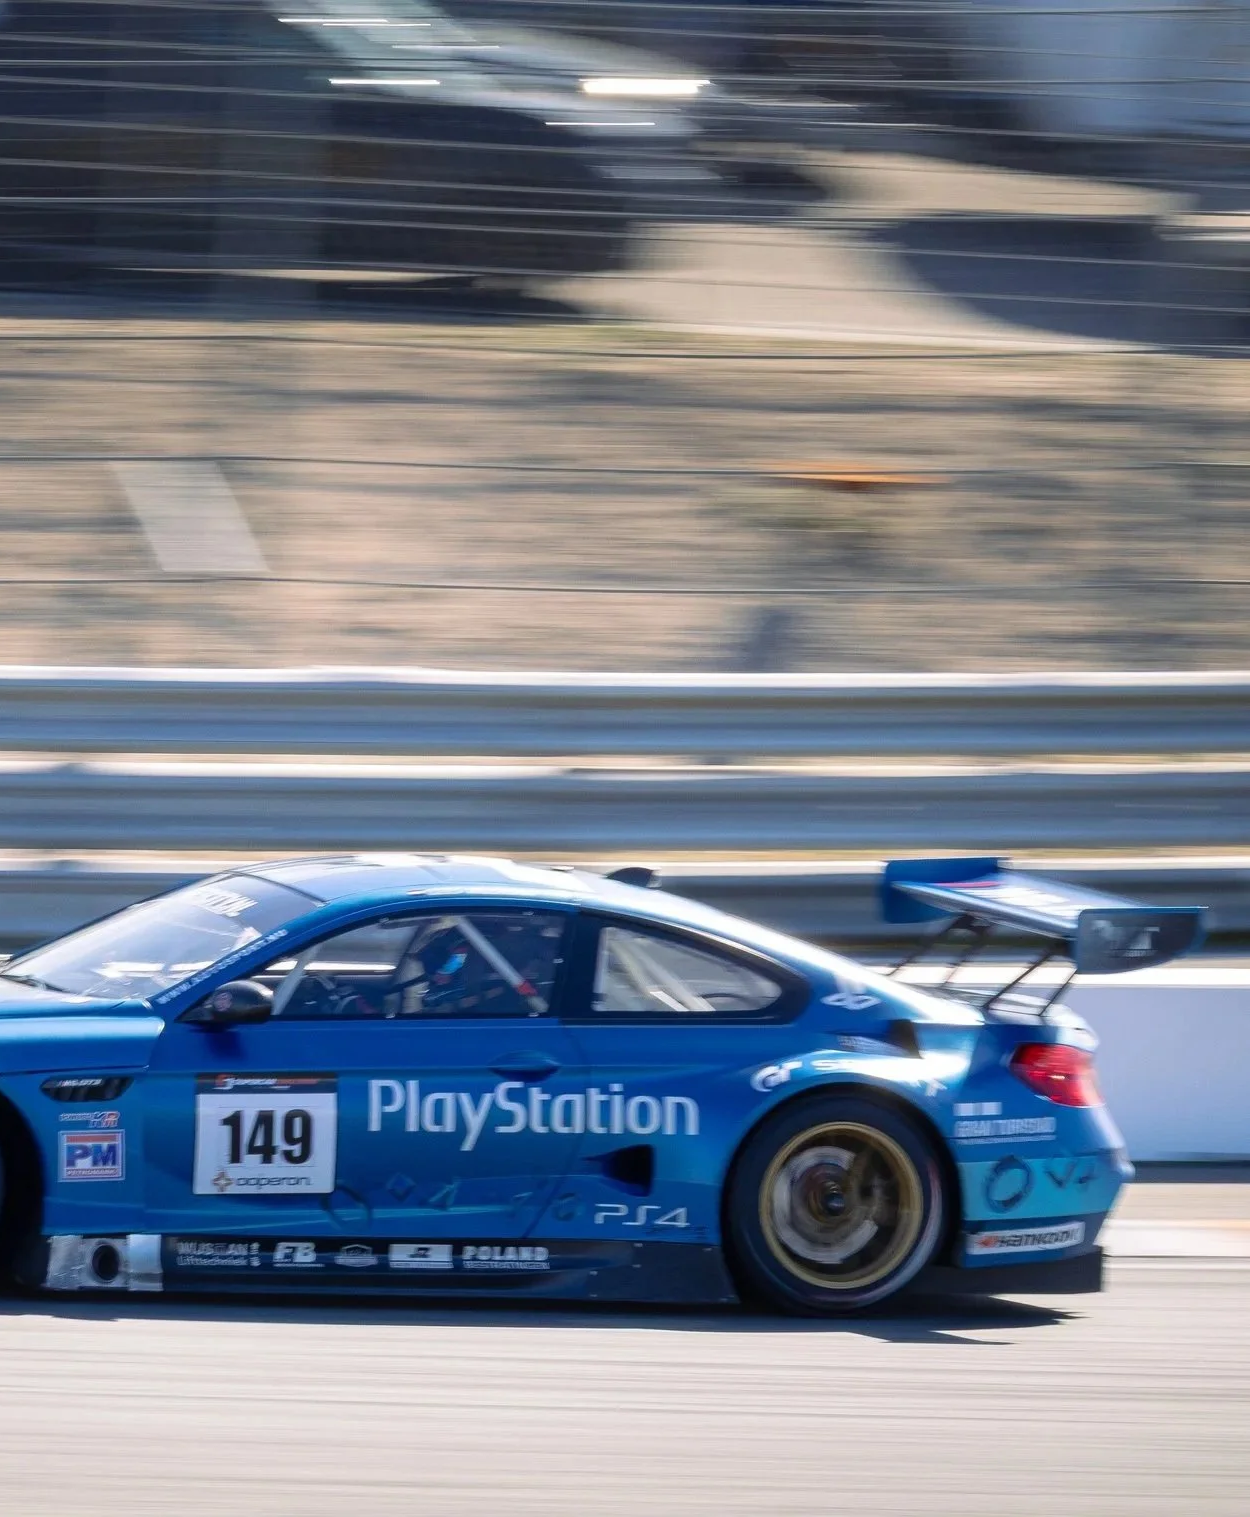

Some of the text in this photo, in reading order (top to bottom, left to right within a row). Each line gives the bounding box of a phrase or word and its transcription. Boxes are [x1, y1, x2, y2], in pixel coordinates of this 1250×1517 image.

[367, 1079, 700, 1151] PlayStation
[220, 1109, 312, 1164] 149
[66, 1144, 117, 1167] PM
[594, 1203, 691, 1228] PS4
[273, 1241, 317, 1263] FB
[462, 1245, 550, 1260] POLAND
